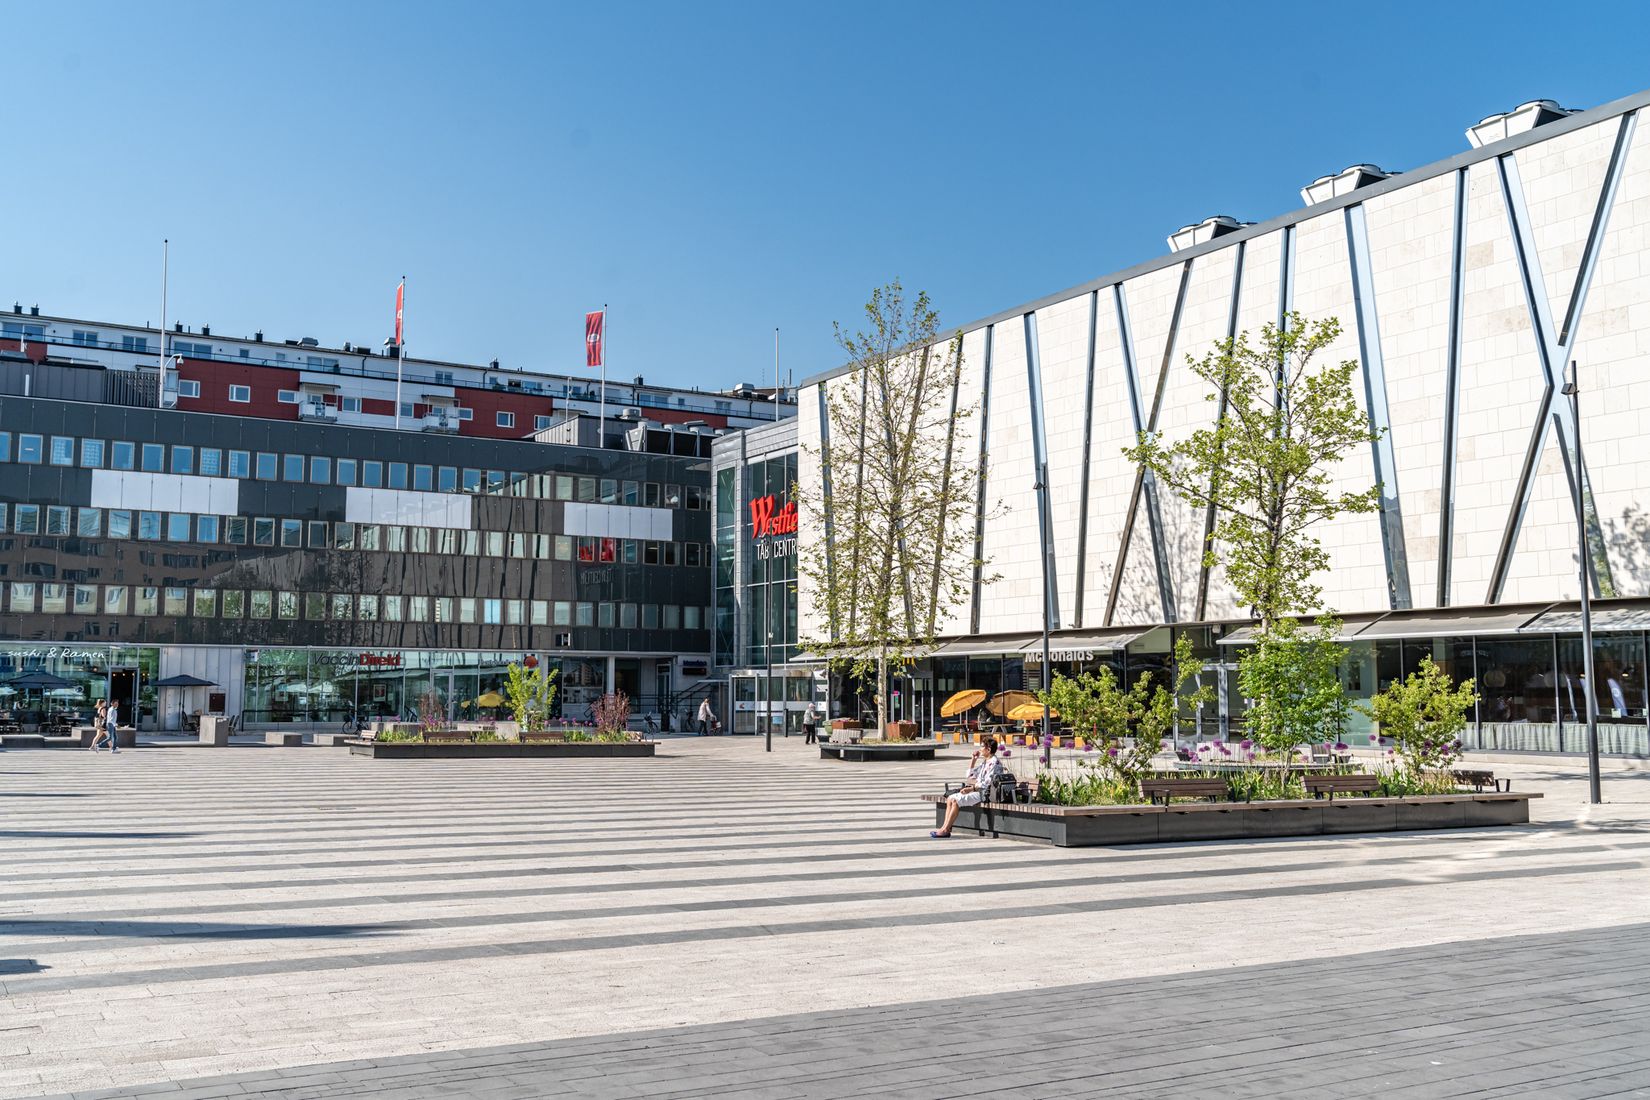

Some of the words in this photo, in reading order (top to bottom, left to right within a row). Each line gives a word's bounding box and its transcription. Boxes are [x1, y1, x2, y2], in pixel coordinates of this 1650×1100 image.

[756, 539, 773, 560] TÄB
[46, 647, 57, 658] &
[60, 648, 105, 659] Ramen
